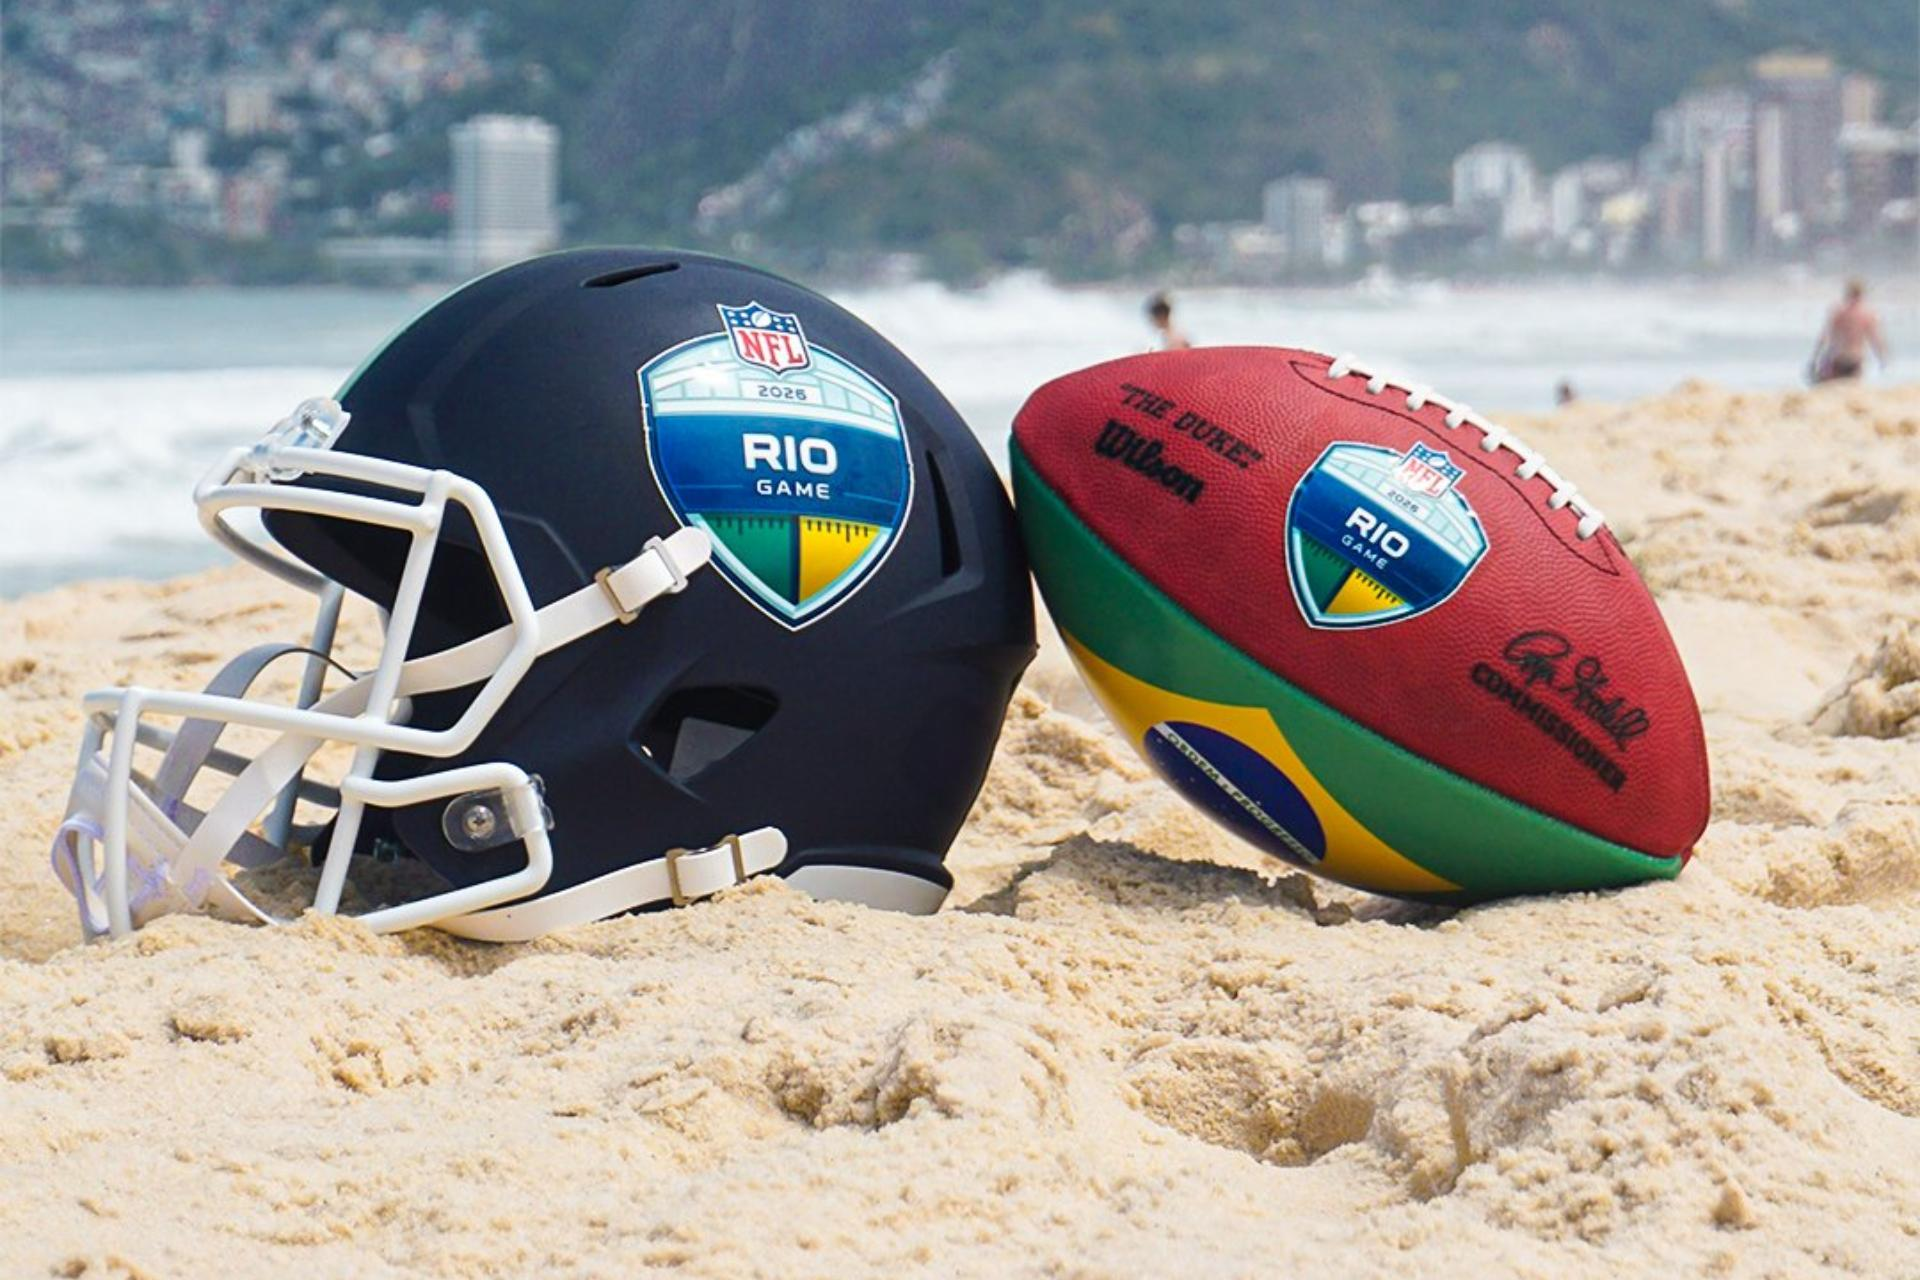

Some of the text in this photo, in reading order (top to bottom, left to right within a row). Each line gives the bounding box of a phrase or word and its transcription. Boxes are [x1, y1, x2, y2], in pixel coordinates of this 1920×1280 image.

[737, 329, 804, 364] NFL
[757, 384, 807, 401] 2026
[742, 433, 838, 475] RIO
[1094, 418, 1205, 504] Wilson
[756, 479, 830, 499] GAME
[1402, 458, 1445, 495] NFL
[1344, 506, 1410, 558] RIO
[1341, 534, 1388, 570] GAME
[1471, 662, 1628, 793] COMMISSIONER
